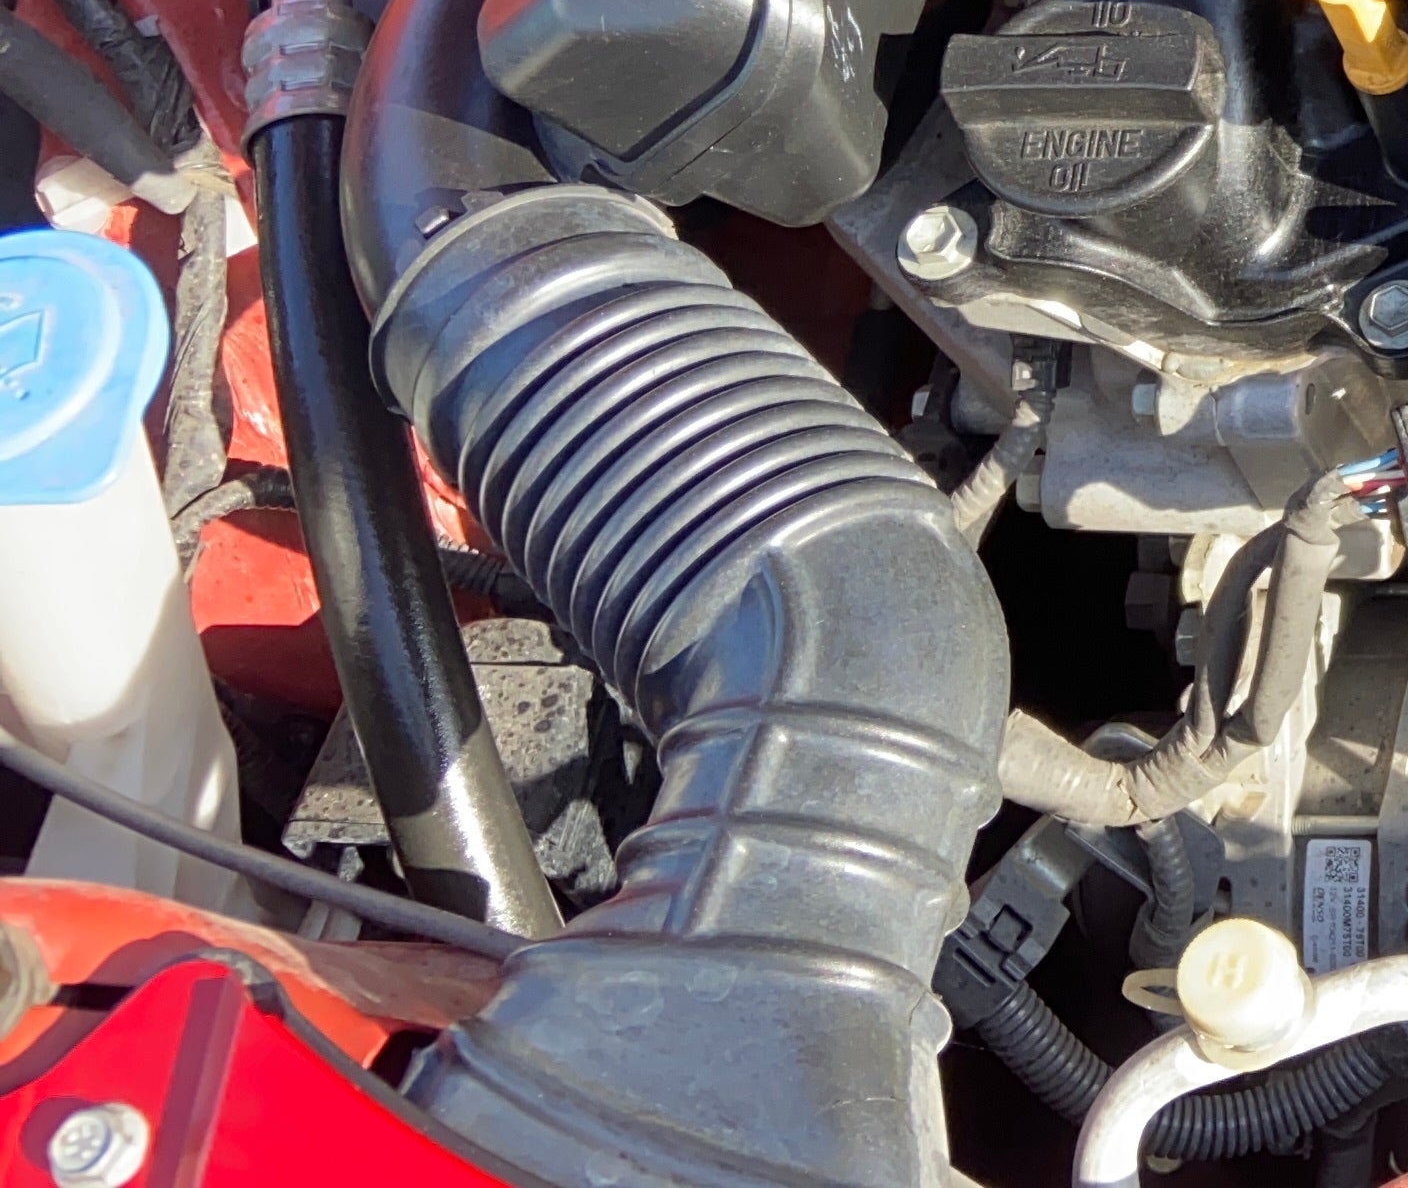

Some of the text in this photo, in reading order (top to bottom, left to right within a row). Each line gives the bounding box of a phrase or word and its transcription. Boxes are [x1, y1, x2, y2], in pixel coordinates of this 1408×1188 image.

[1020, 129, 1143, 160] ENGINE
[1050, 162, 1091, 192] OIL
[1316, 887, 1325, 923] DENSO
